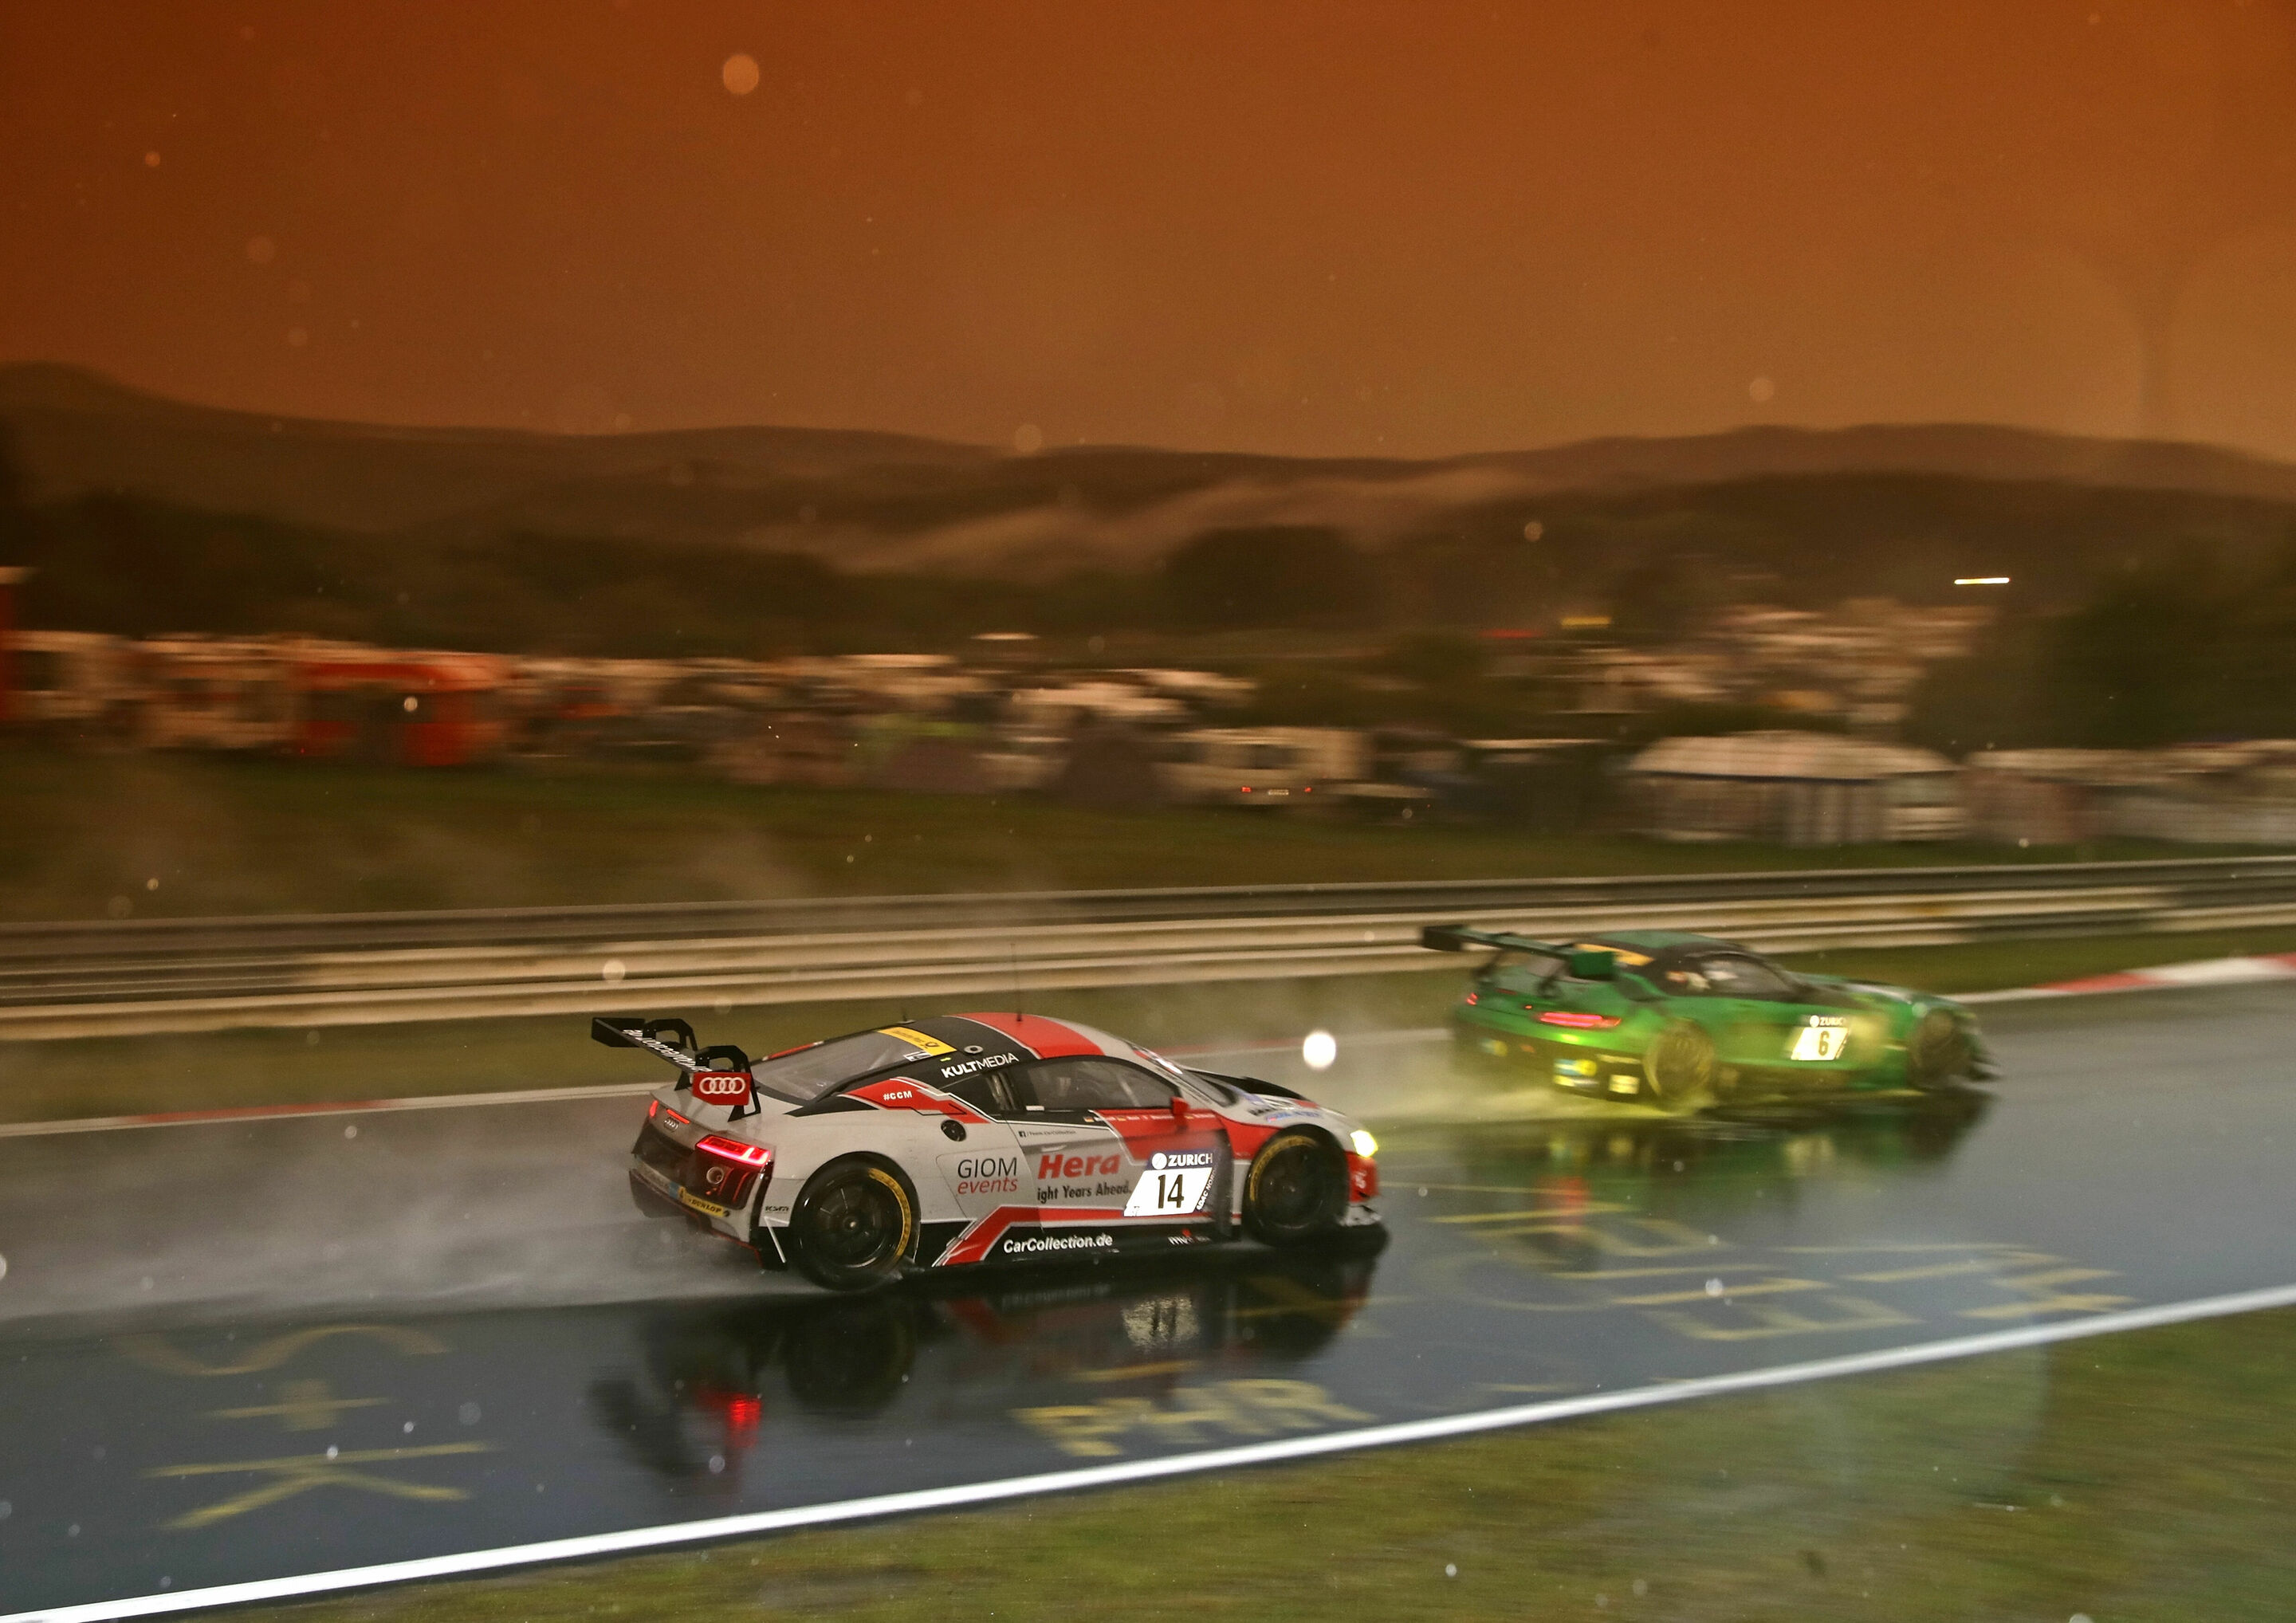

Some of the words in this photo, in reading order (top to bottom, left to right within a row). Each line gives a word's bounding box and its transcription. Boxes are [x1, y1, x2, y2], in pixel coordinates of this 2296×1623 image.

[1818, 1030, 1830, 1057] 6
[941, 1052, 1019, 1078] KULTMEDIA
[883, 1090, 913, 1101] #CCM
[957, 1157, 1018, 1178] GIOM
[1037, 1153, 1121, 1180] Hera
[1168, 1153, 1213, 1167] ZURICH
[957, 1177, 1019, 1195] events
[1063, 1185, 1092, 1201] Years
[1158, 1173, 1185, 1209] 14
[1003, 1233, 1114, 1254] CarCollection.de
